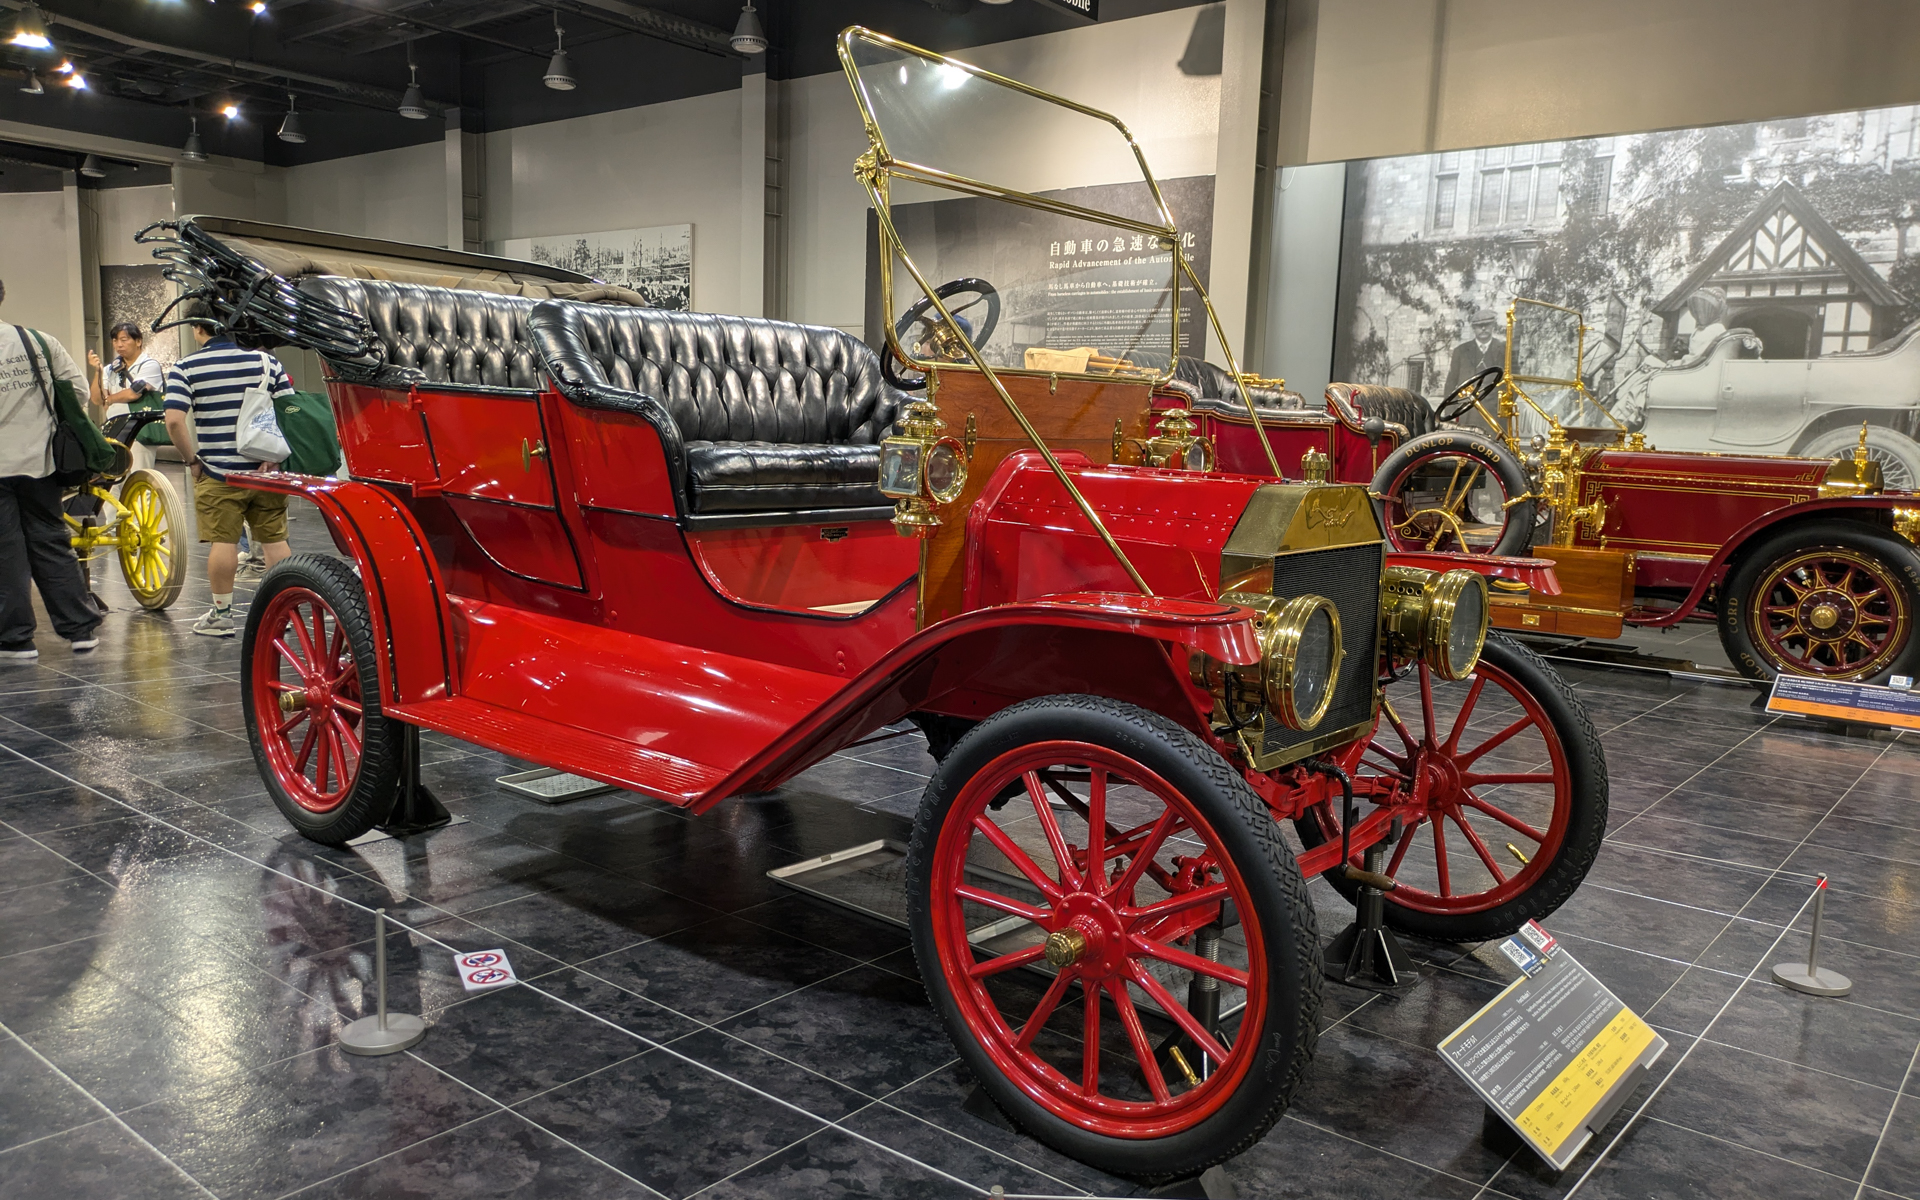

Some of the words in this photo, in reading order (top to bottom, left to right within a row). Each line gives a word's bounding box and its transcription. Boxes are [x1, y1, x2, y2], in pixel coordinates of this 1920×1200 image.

[1050, 232, 1195, 256] 自動車の急速な化
[1049, 260, 1070, 270] Rapid
[1072, 258, 1121, 268] Advancement
[1123, 256, 1132, 265] of
[1134, 256, 1146, 265] the
[1149, 254, 1194, 264] Autoile
[0, 370, 11, 380] th
[12, 367, 29, 376] the
[1, 382, 10, 392] of
[1405, 437, 1454, 458] DUNLOP
[1470, 441, 1501, 463] CORD
[1727, 597, 1739, 634] CORD
[1740, 651, 1772, 681] NLOP
